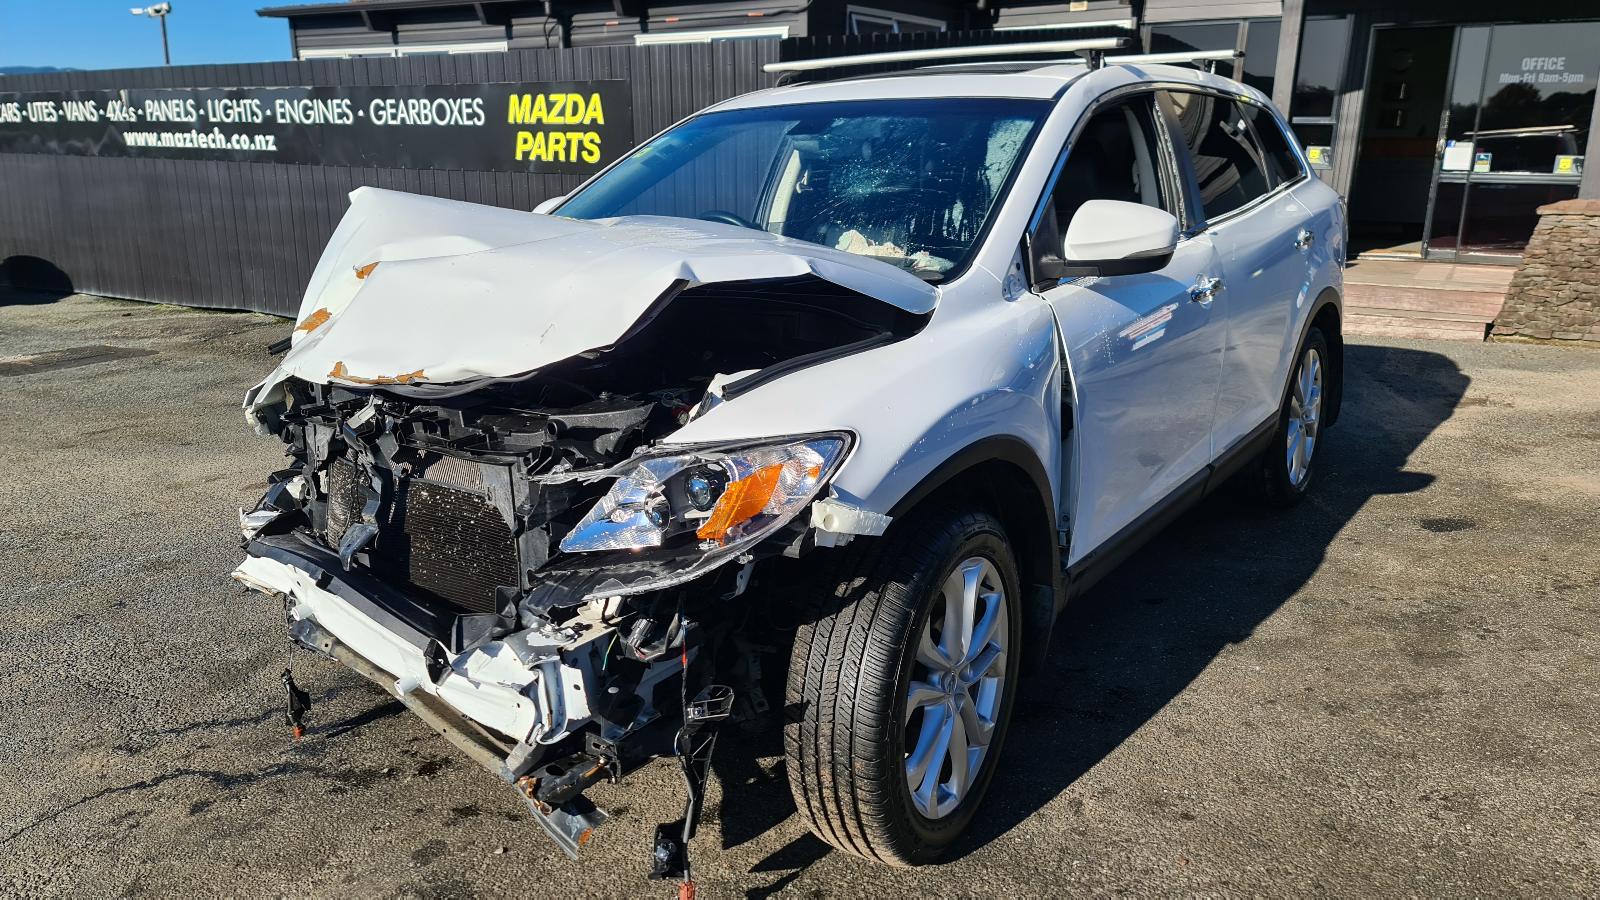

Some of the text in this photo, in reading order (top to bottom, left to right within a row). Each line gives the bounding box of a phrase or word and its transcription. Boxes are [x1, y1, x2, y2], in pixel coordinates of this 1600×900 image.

[1521, 57, 1566, 71] OFFICE
[1499, 73, 1536, 84] Mon-Fri
[27, 101, 58, 122] UTES
[62, 100, 99, 122] VANS
[145, 99, 197, 122] PANELS
[208, 99, 263, 123] LIGHTS
[276, 98, 353, 125] ENGINES
[369, 97, 485, 126] GEARBOXES
[507, 93, 605, 125] MAZDA
[123, 128, 277, 151] www.maztech.co.nz
[515, 131, 602, 164] PARTS
